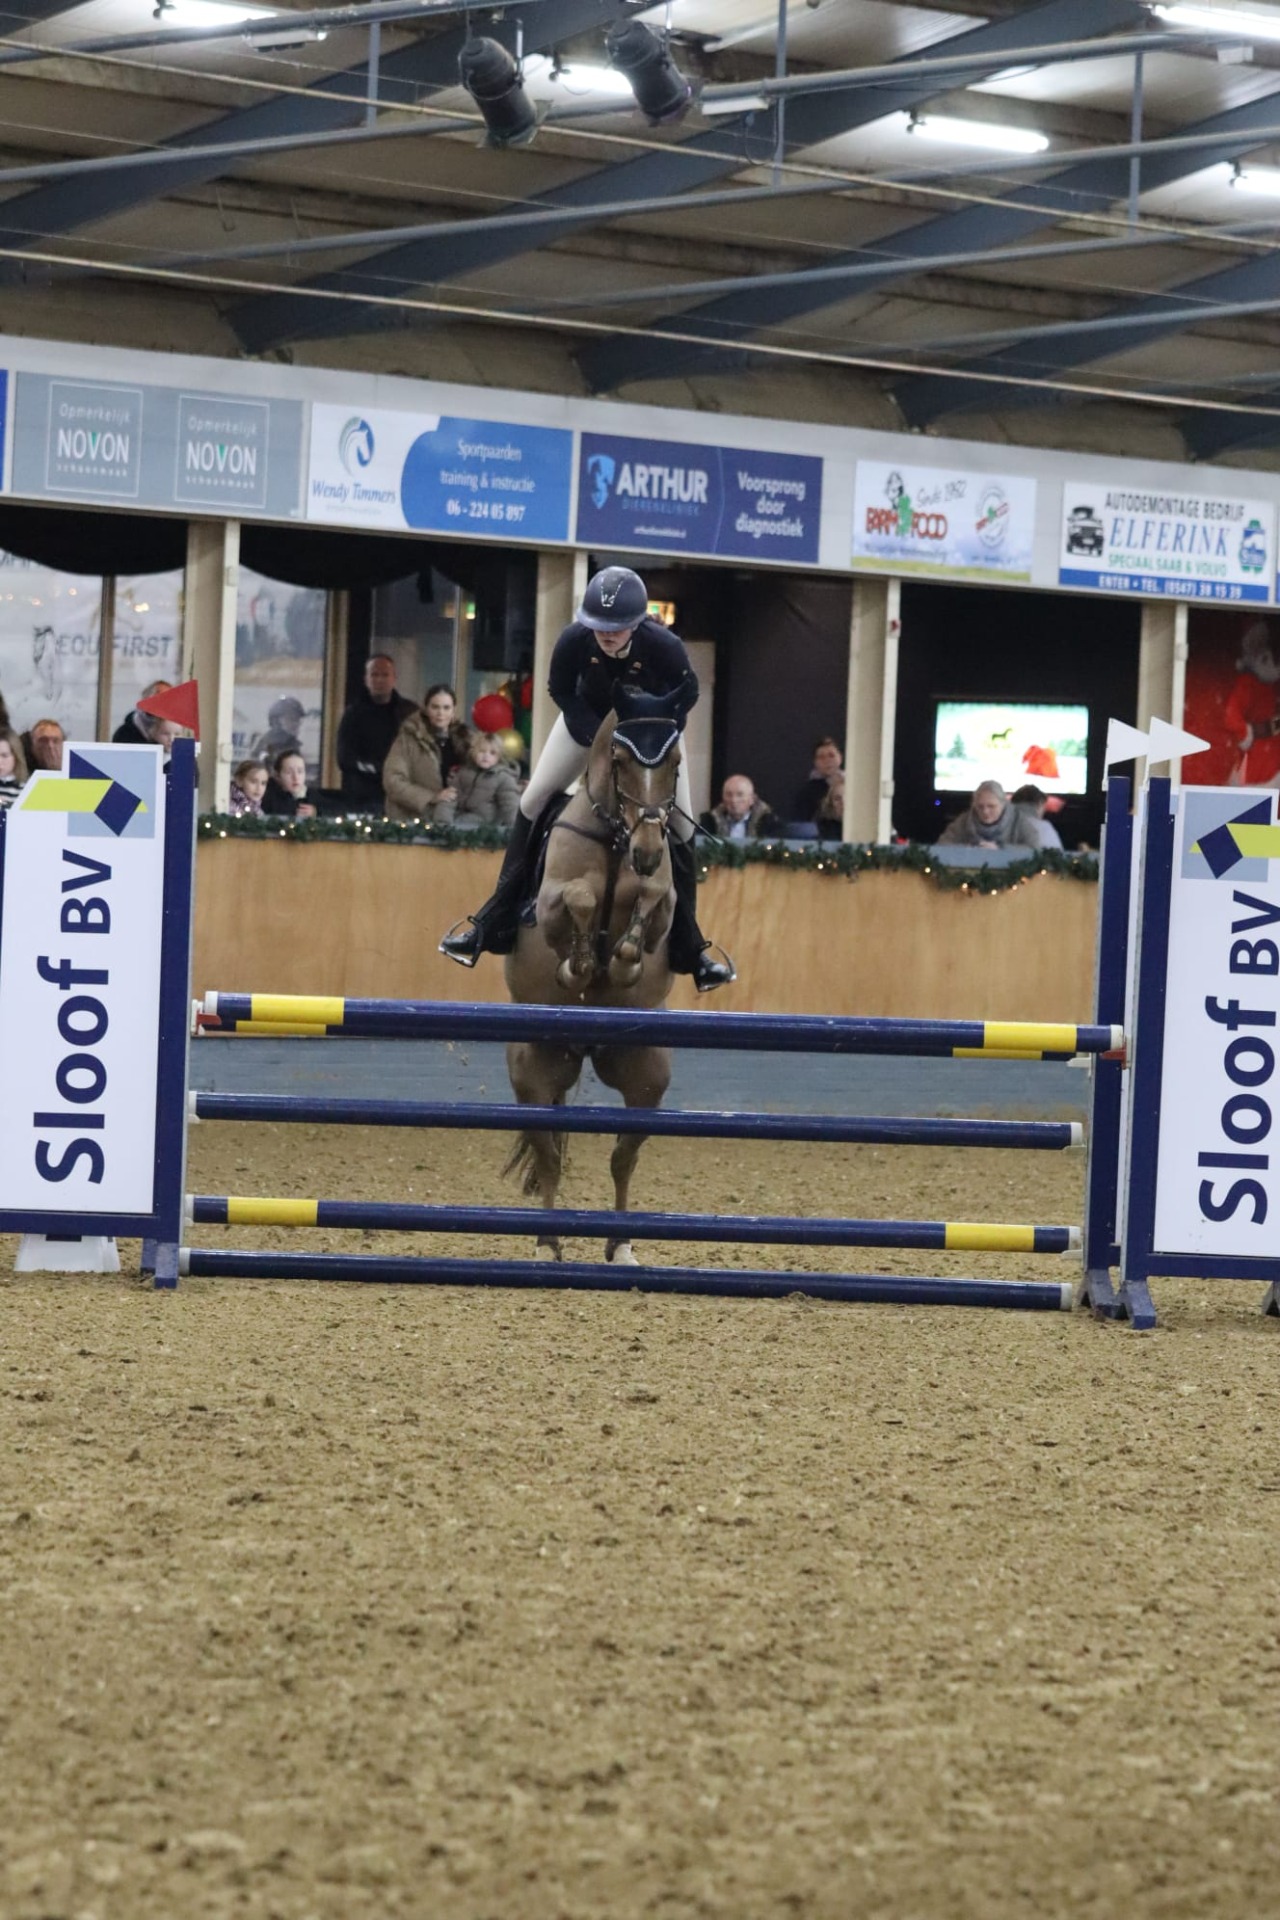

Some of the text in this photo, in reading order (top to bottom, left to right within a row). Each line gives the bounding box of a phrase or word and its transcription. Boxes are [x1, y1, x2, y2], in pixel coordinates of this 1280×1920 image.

[57, 428, 130, 464] NOVON
[186, 440, 257, 476] NOVON
[458, 438, 522, 462] Sportpaarden
[312, 479, 396, 504] Wendy Timmers
[440, 471, 478, 492] training
[491, 474, 535, 493] instructie
[616, 462, 708, 504] ARTHUR
[737, 471, 806, 500] Voorsprong
[756, 497, 786, 516] door
[1105, 492, 1200, 518] AUTODEMONTAGE
[735, 512, 804, 539] diagnostiek
[1109, 517, 1231, 556] ELFERINK
[33, 849, 112, 1184] Sloof BV
[1198, 890, 1280, 1225] Sloof BV
